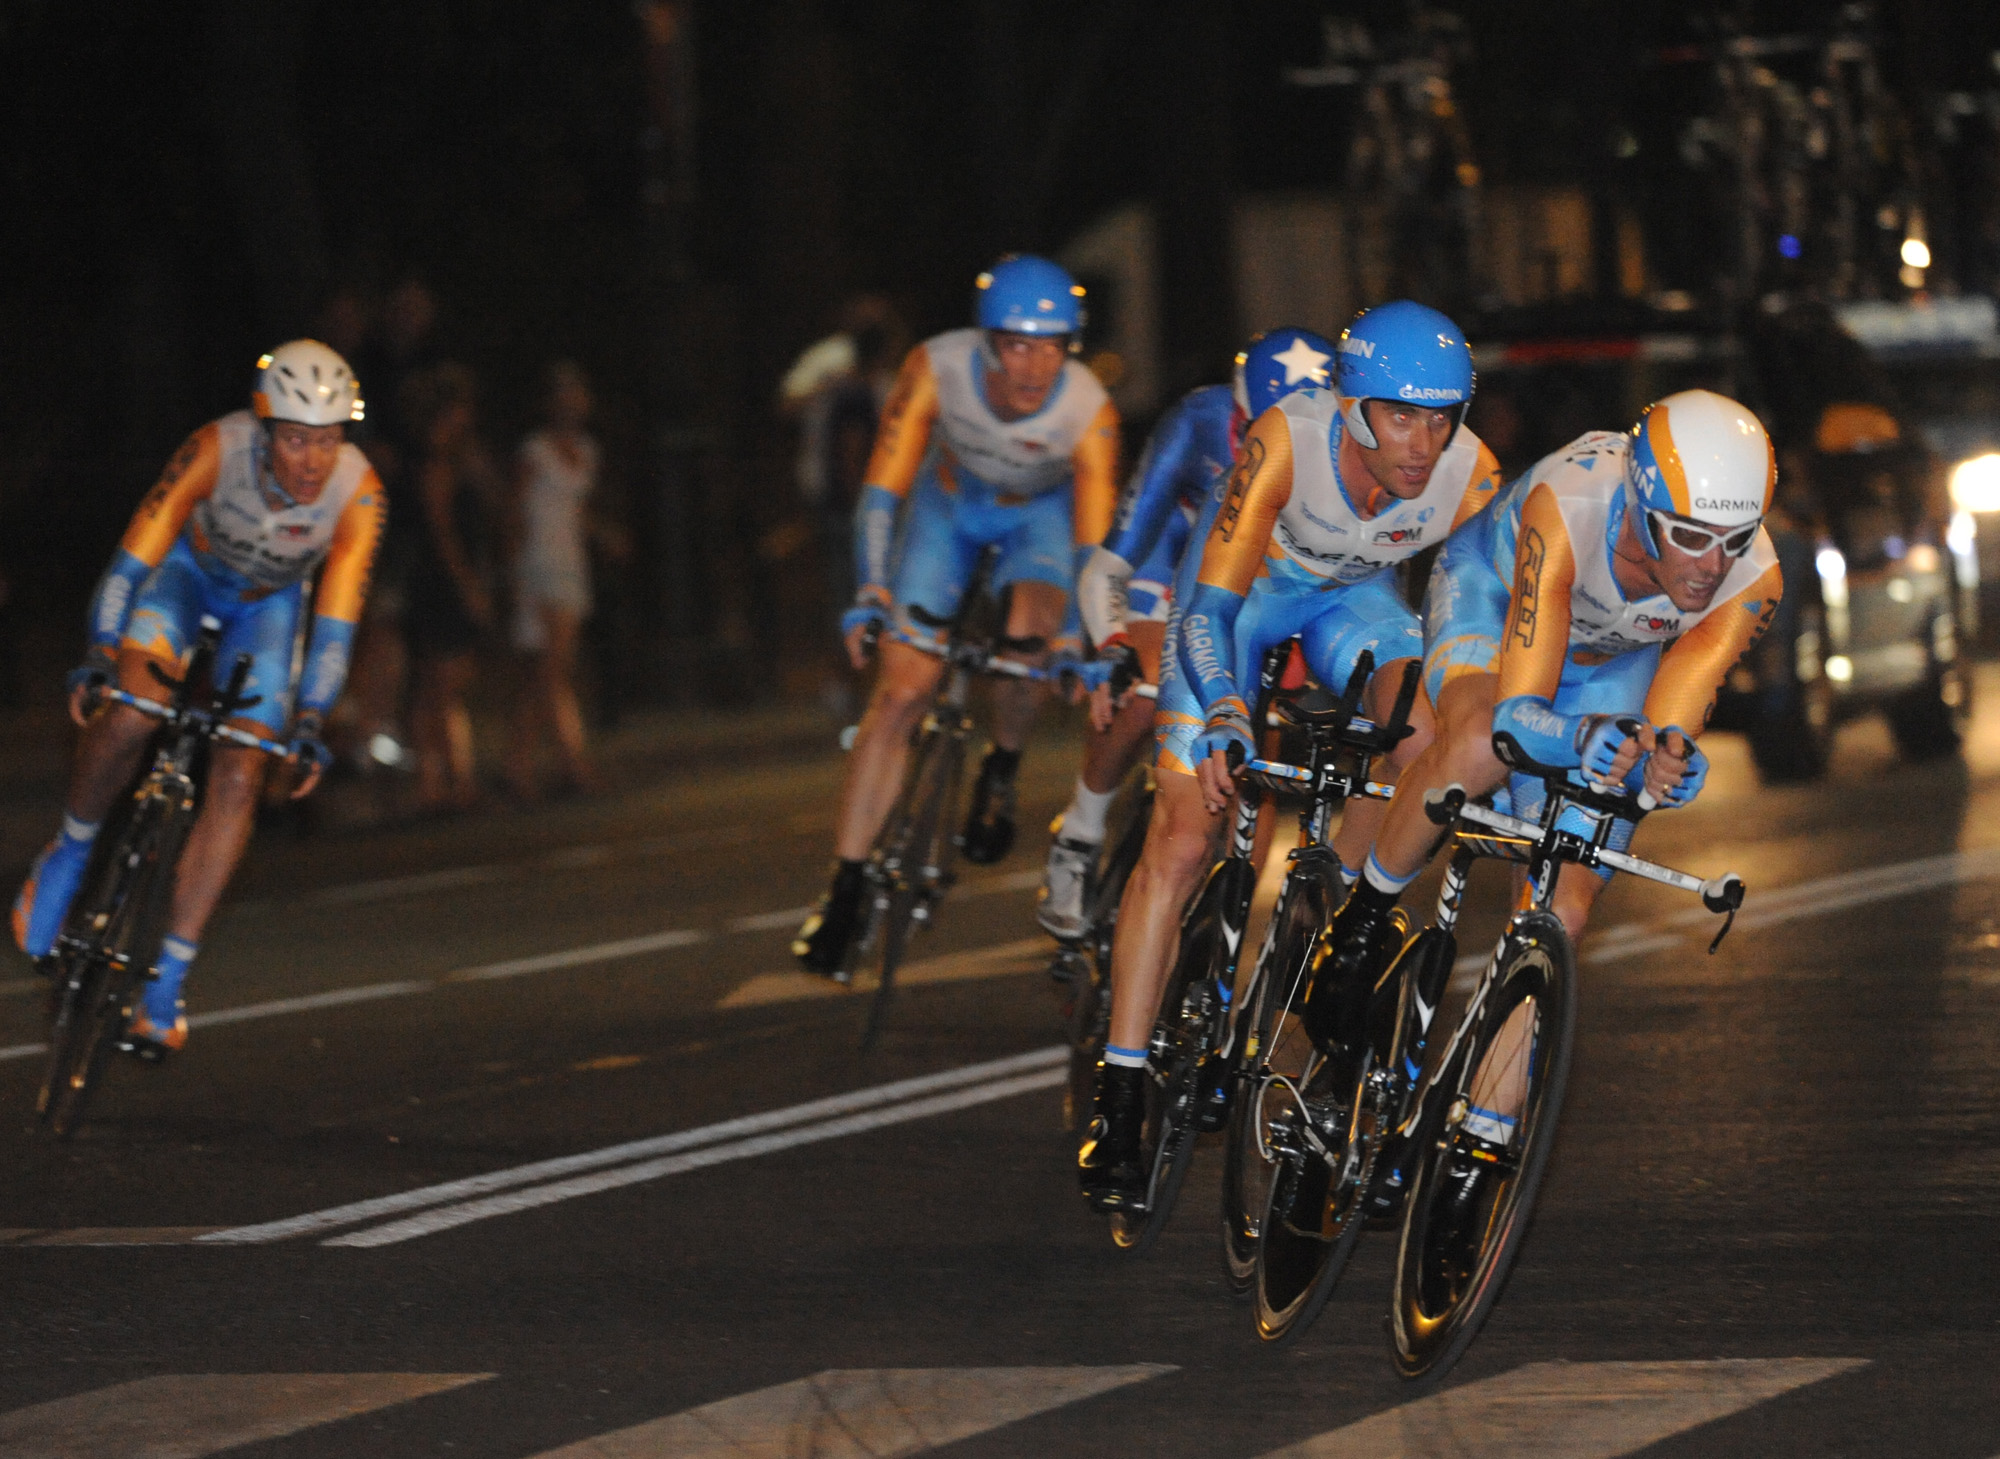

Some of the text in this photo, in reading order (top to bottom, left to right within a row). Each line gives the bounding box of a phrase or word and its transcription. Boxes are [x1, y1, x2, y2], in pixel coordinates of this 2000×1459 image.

[1398, 385, 1463, 401] GARMIN
[1694, 497, 1761, 512] GARMIN
[1515, 525, 1547, 648] FELT
[1182, 614, 1224, 684] GARMIN
